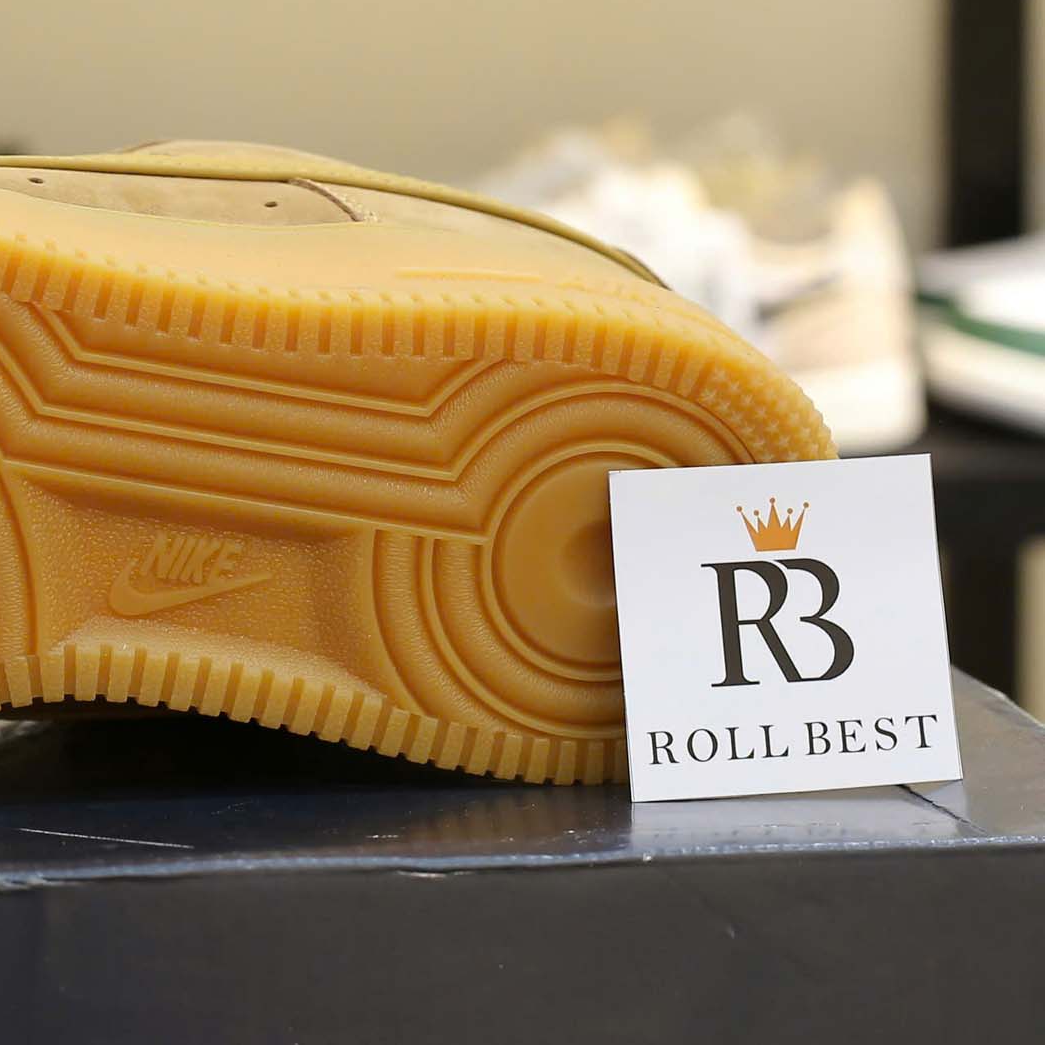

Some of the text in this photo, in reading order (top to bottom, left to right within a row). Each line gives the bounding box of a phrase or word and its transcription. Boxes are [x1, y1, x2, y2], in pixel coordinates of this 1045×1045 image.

[139, 530, 242, 584] NIKE
[647, 714, 938, 765] ROLL BEST
